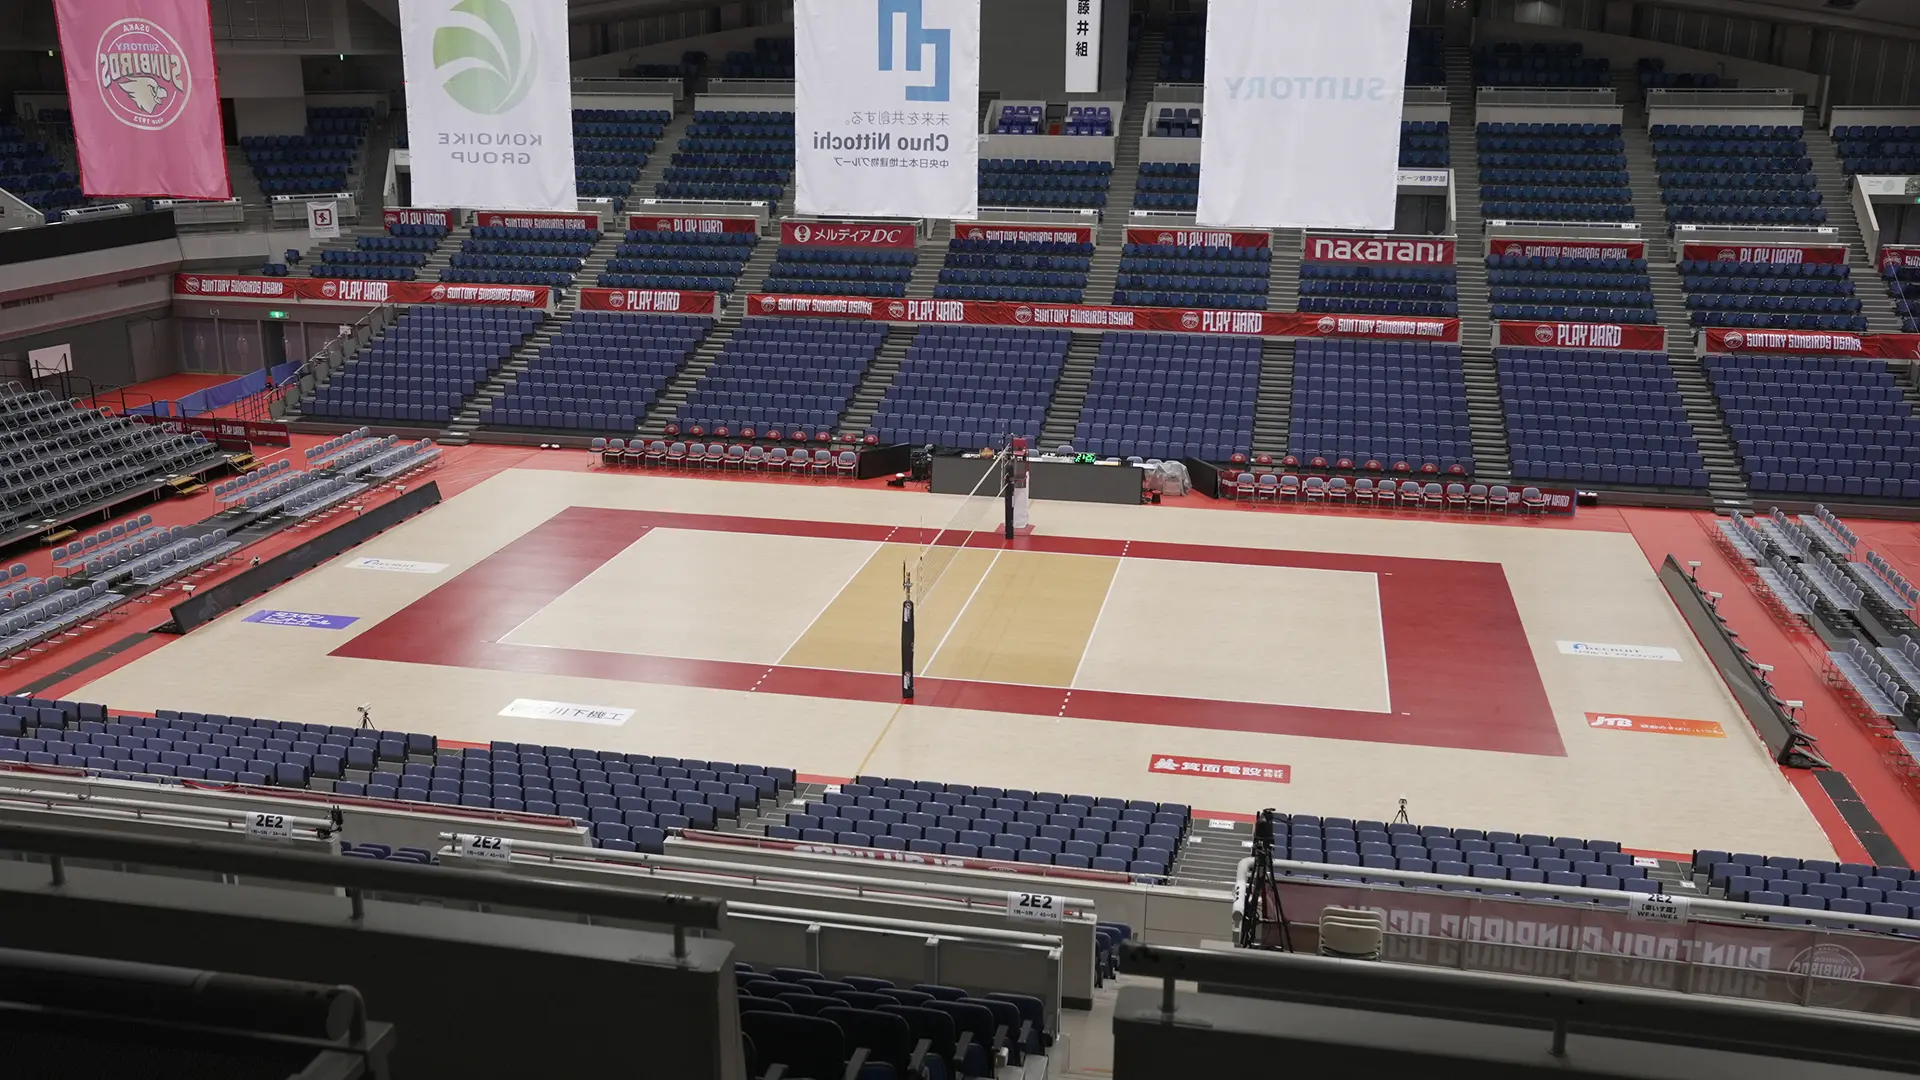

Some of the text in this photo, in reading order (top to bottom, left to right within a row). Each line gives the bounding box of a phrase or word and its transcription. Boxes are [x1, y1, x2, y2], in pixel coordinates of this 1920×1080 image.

[201, 278, 231, 293] SUNTORY
[339, 280, 389, 301] PLAY HARD
[447, 286, 478, 300] SUNTORY
[627, 290, 681, 311] PLAY HARD
[778, 298, 872, 315] SUNTORY SUNBIRDS OSAKA
[907, 300, 964, 322] PLAY HARD
[1034, 308, 1134, 326] SUNTORY SUNBIRDS OSAKA
[1202, 311, 1262, 333] PLAY HARD
[1338, 318, 1444, 337] SUNTORY SUNBIRDS OSAKA
[1557, 324, 1622, 347] PLAY HARD
[1747, 333, 1862, 351] SUNTORY SUNBIRDS OSAKA
[1591, 716, 1633, 728] JTB
[256, 814, 284, 829] 2E2
[472, 835, 502, 850] 2E2
[1019, 893, 1053, 909] 2E2
[1648, 893, 1673, 904] 2E2
